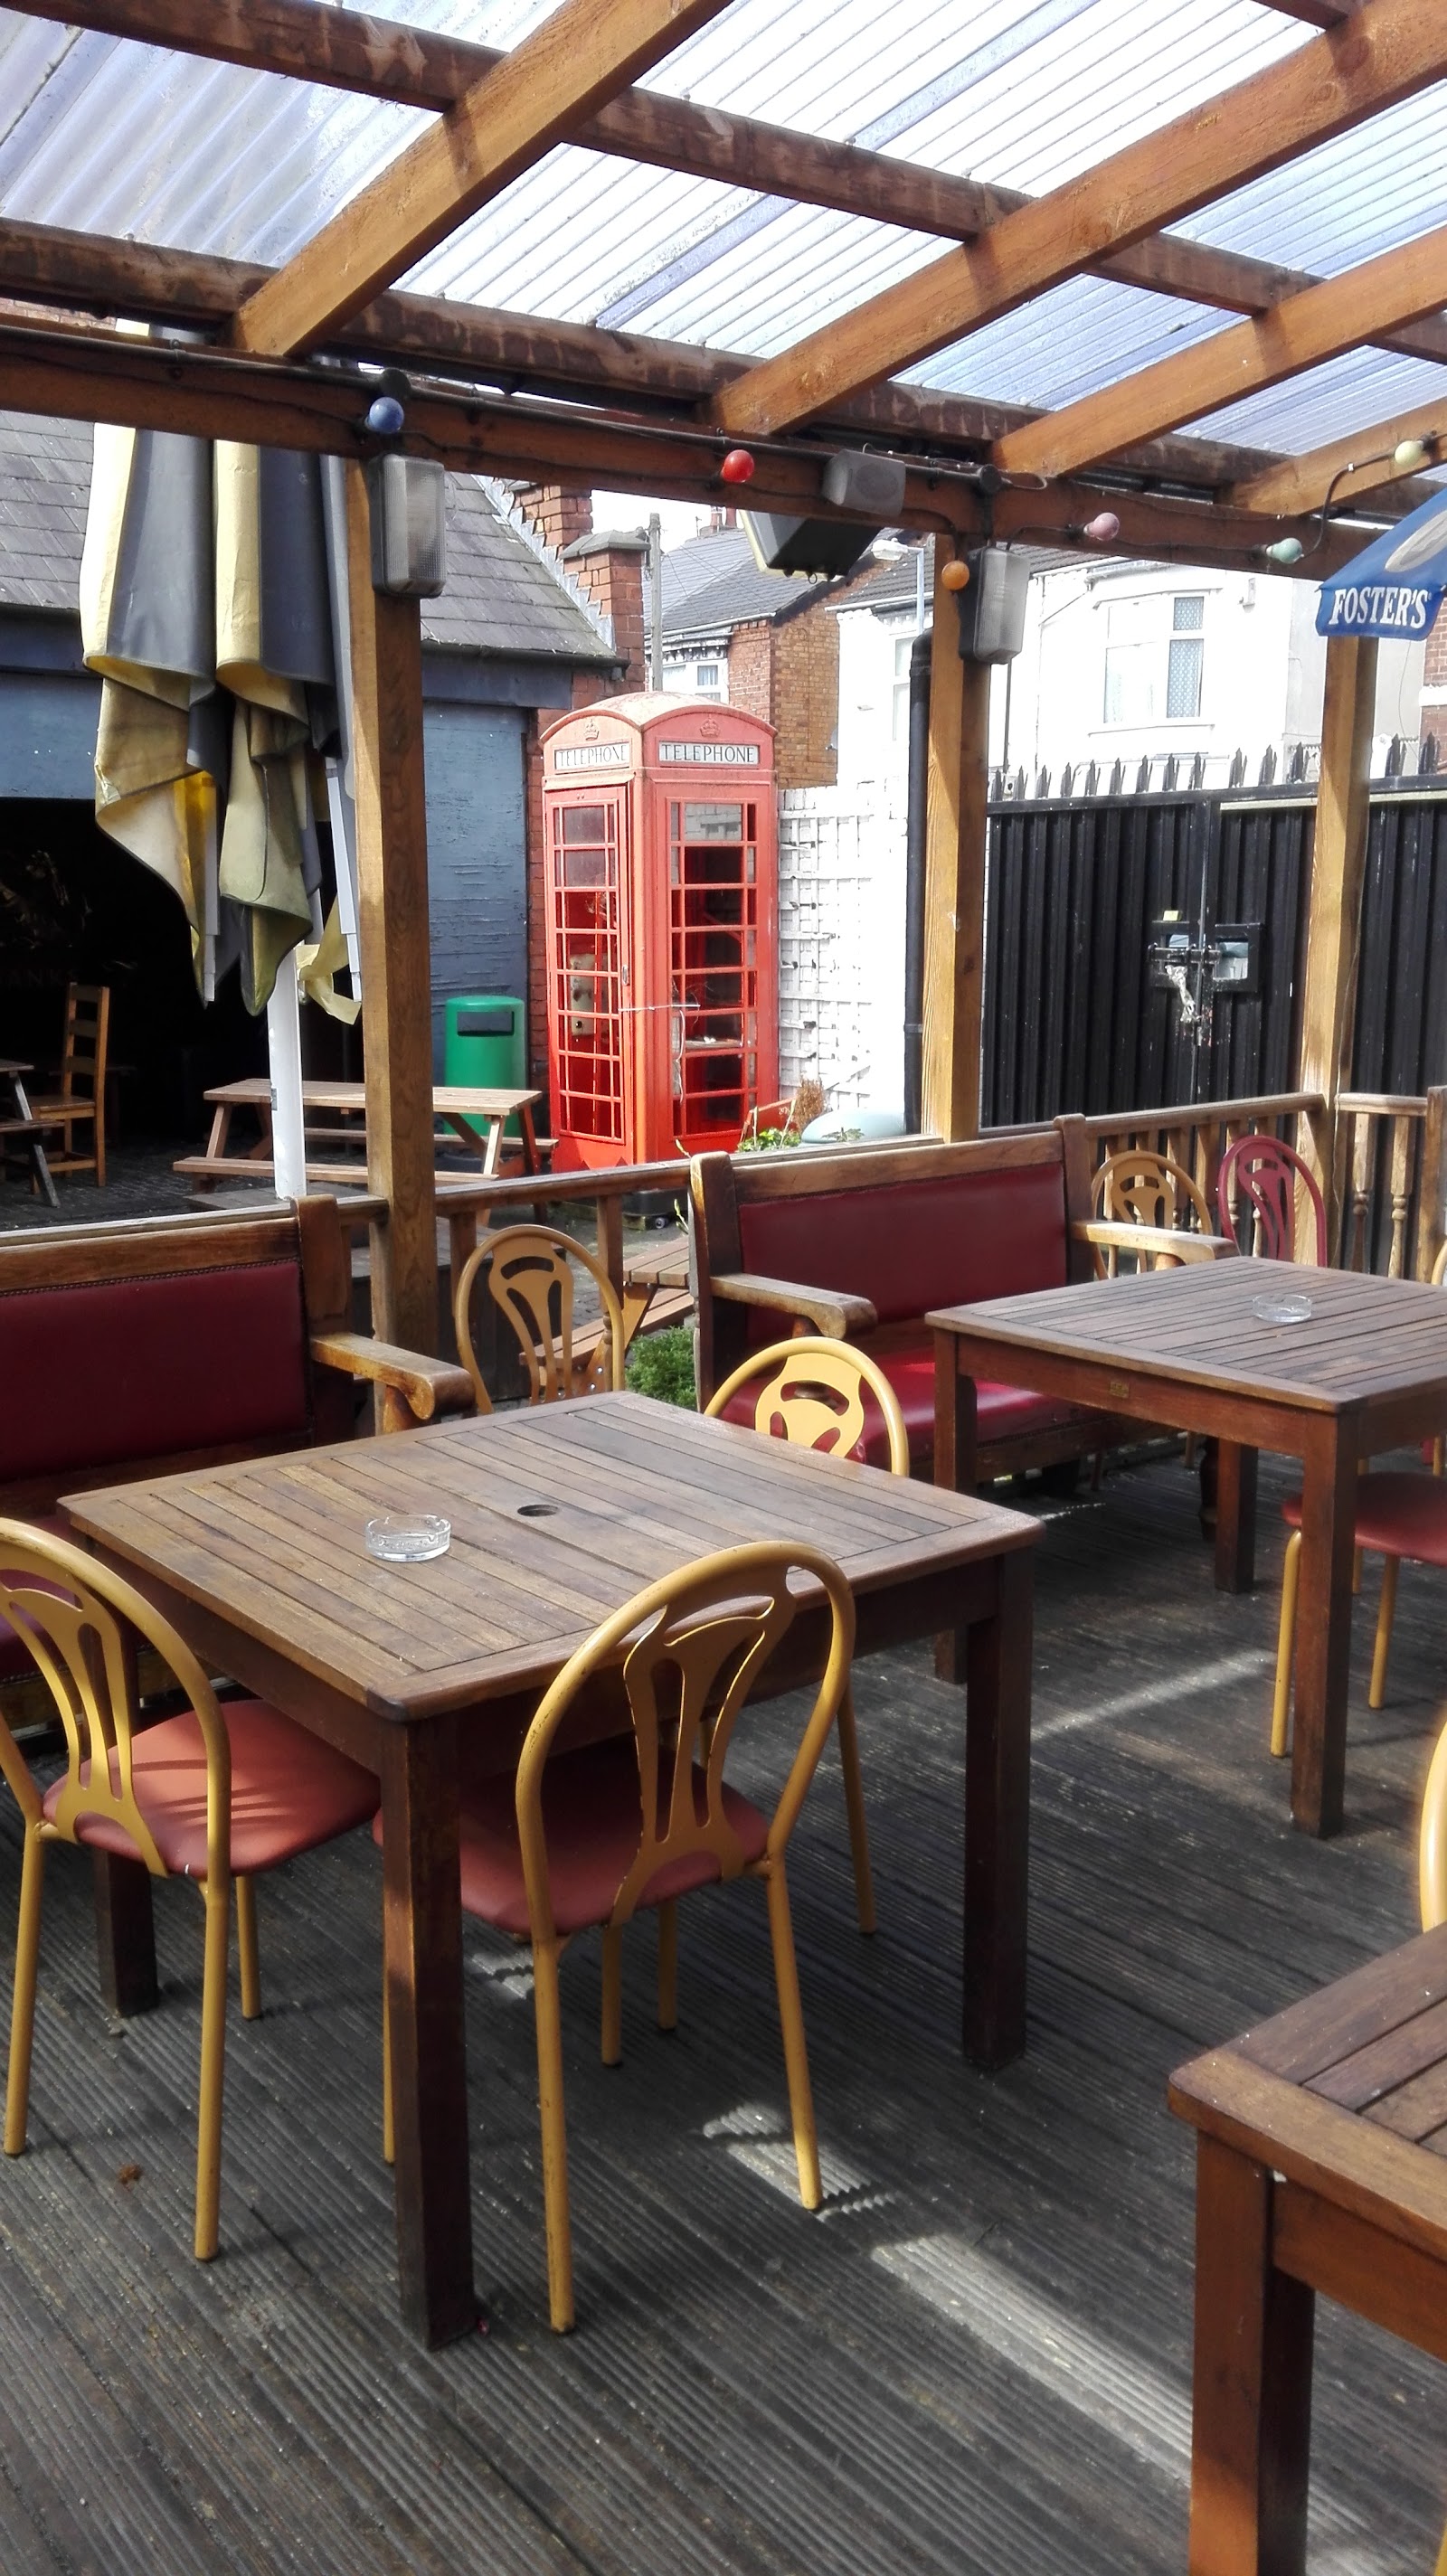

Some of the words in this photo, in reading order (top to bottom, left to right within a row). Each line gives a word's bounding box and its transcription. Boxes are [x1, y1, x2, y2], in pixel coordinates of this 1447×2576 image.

[1329, 587, 1429, 629] FOSTER'S
[559, 744, 627, 767] TELEPHONE
[661, 743, 755, 763] TELEPHONE
